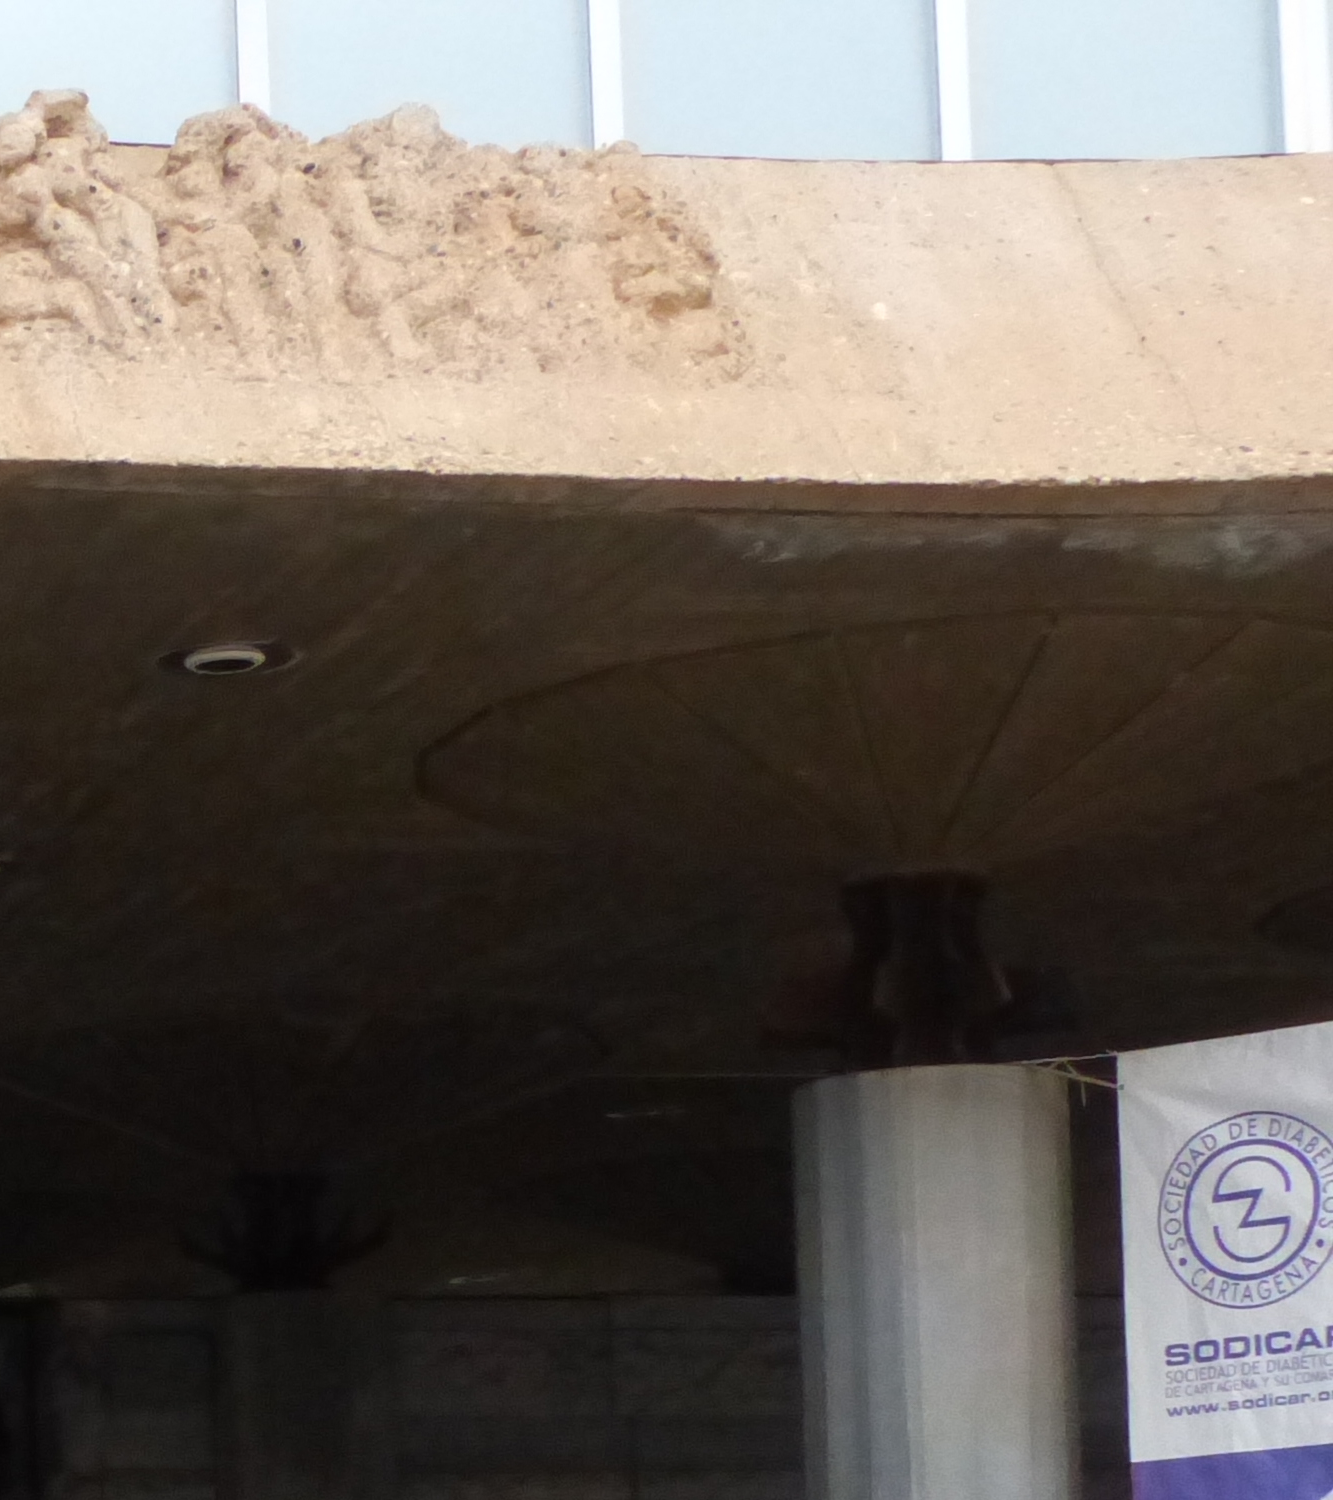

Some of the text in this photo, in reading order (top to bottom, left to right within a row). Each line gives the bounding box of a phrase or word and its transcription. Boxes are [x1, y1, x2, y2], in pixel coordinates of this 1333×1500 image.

[1163, 1133, 1218, 1251] SOCIEDAD
[1228, 1118, 1258, 1140] DE
[1190, 1255, 1319, 1303] CARTAGENA
[1165, 1364, 1237, 1385] SOCIEDAD
[1240, 1361, 1260, 1376] DE
[1165, 1386, 1181, 1399] DE
[1185, 1379, 1258, 1396] CARTAGENA
[1261, 1377, 1270, 1388] Y
[1274, 1374, 1290, 1386] SU
